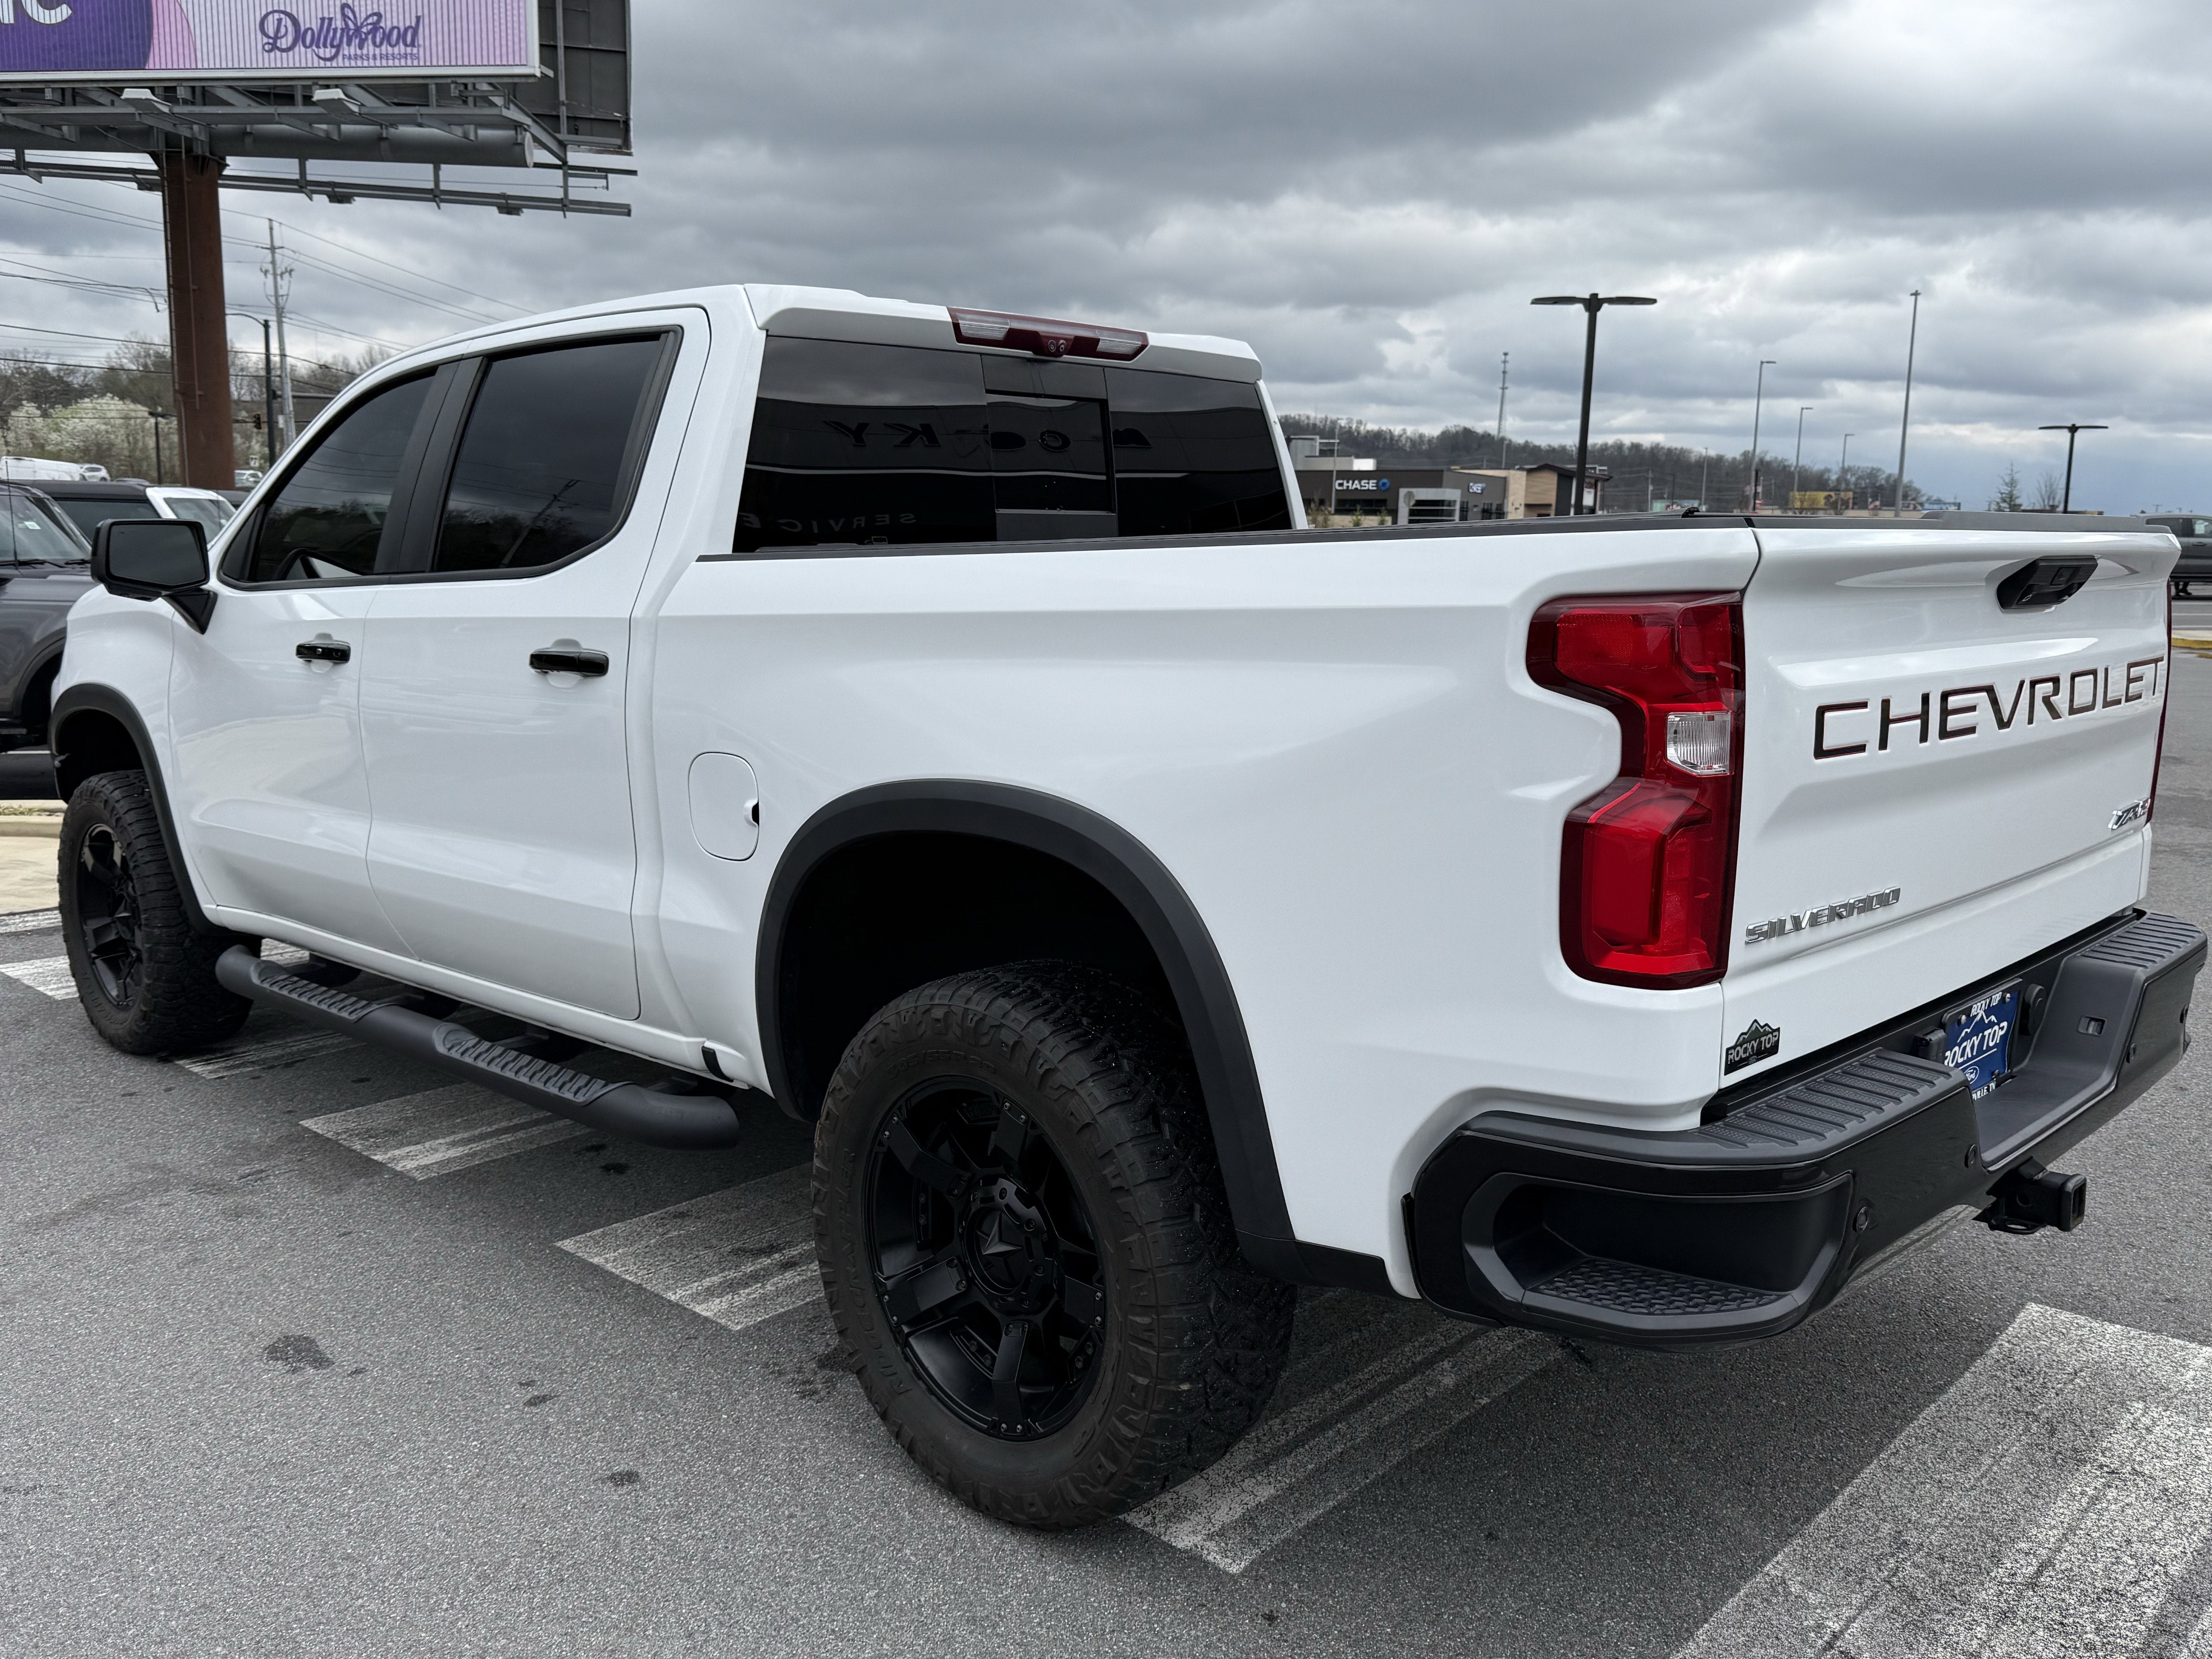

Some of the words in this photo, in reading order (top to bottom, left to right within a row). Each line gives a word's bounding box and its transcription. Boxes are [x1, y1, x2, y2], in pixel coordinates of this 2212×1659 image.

[259, 2, 421, 62] Dollywood
[1335, 480, 1377, 490] CHASE
[1813, 656, 2164, 759] CHEVROLET
[1745, 886, 1901, 945] SILVERADO
[1970, 997, 1991, 1017] ROCKY
[1990, 992, 2002, 1007] TOP
[1728, 1039, 1759, 1064] ROCKY
[1760, 1031, 1779, 1050] TOP
[1944, 1033, 1982, 1067] ROCKY
[1983, 1021, 2008, 1050] TOP
